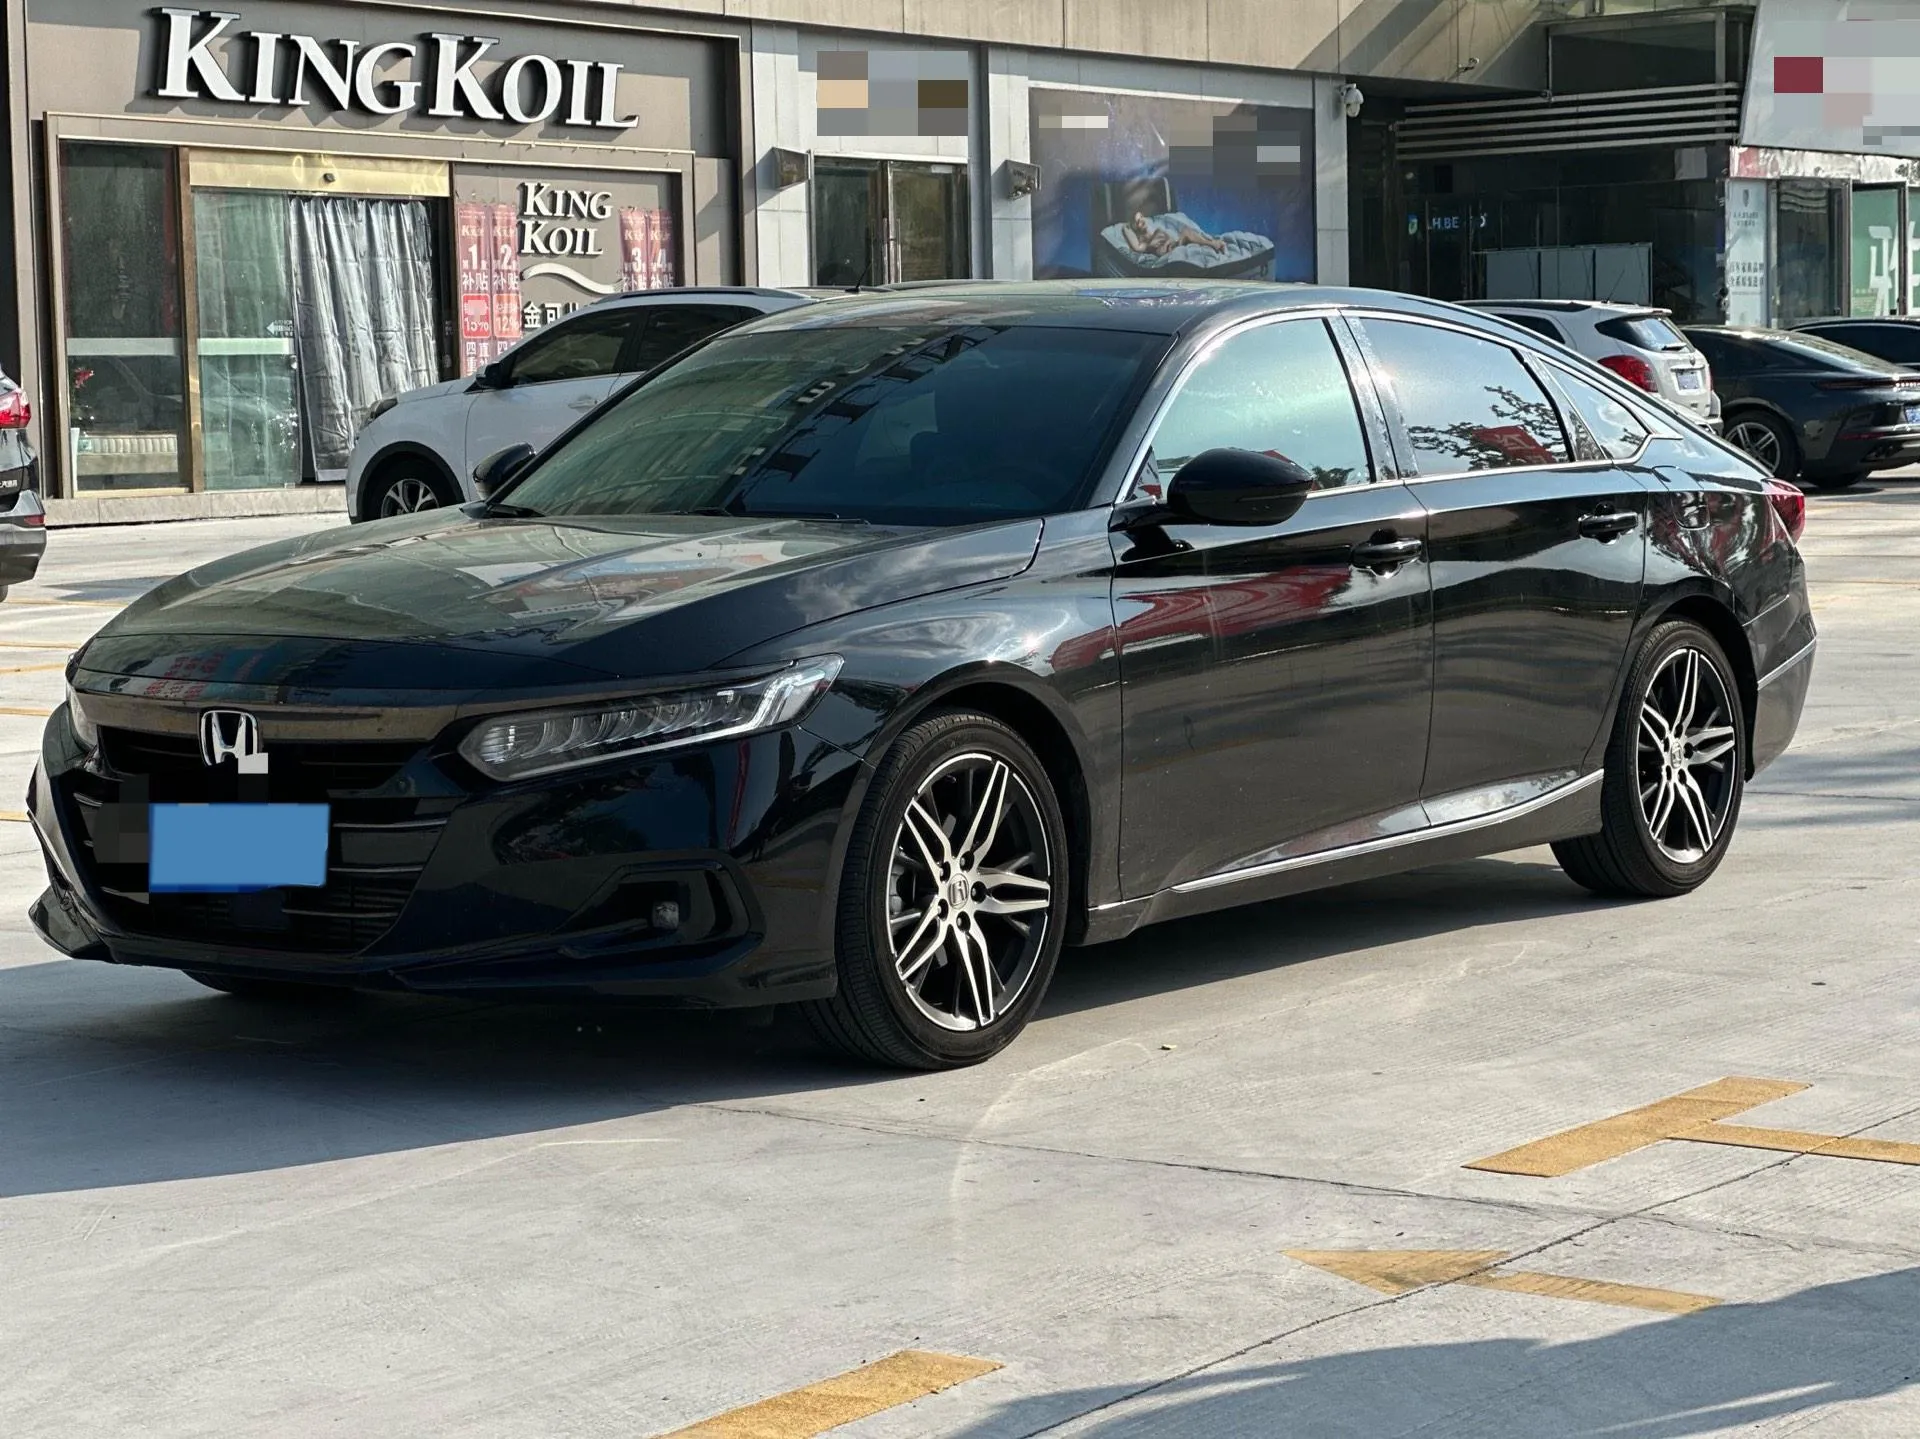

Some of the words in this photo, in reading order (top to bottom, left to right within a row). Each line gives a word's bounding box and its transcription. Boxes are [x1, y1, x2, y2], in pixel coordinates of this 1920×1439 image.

[523, 182, 613, 219] KING
[520, 220, 603, 255] KOIL
[462, 271, 488, 290] 补贴
[492, 271, 519, 290] 补贴
